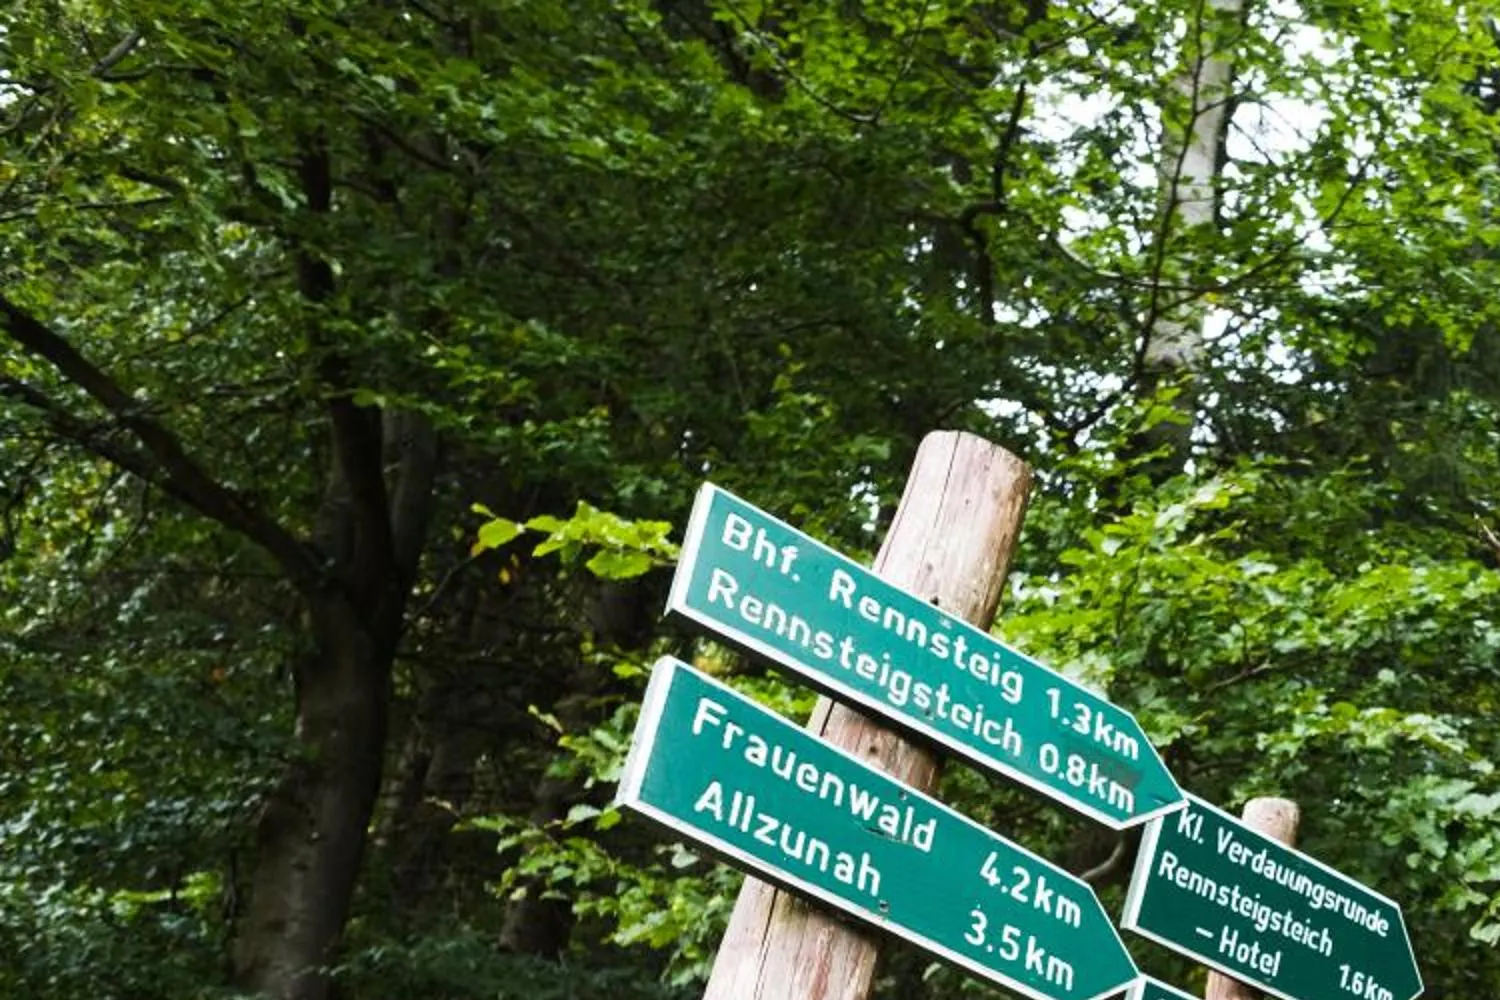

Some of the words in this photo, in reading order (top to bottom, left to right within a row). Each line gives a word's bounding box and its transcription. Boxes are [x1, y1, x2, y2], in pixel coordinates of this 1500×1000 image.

[706, 567, 1023, 758] Rennsteigsteich
[1038, 742, 1136, 815] 0.8km
[721, 511, 800, 581] Bhf.
[829, 569, 1024, 704] Rennsteig
[1044, 687, 1140, 761] 1.3km
[692, 697, 937, 855] Frauenwald
[979, 850, 1082, 929] 4.2km
[694, 780, 883, 897] Allzunah
[963, 908, 1075, 992] 3.5km
[1157, 850, 1334, 957] Rennsteigsteich
[1177, 807, 1205, 845] Kl.
[1216, 826, 1390, 938] Verdauungsrunde
